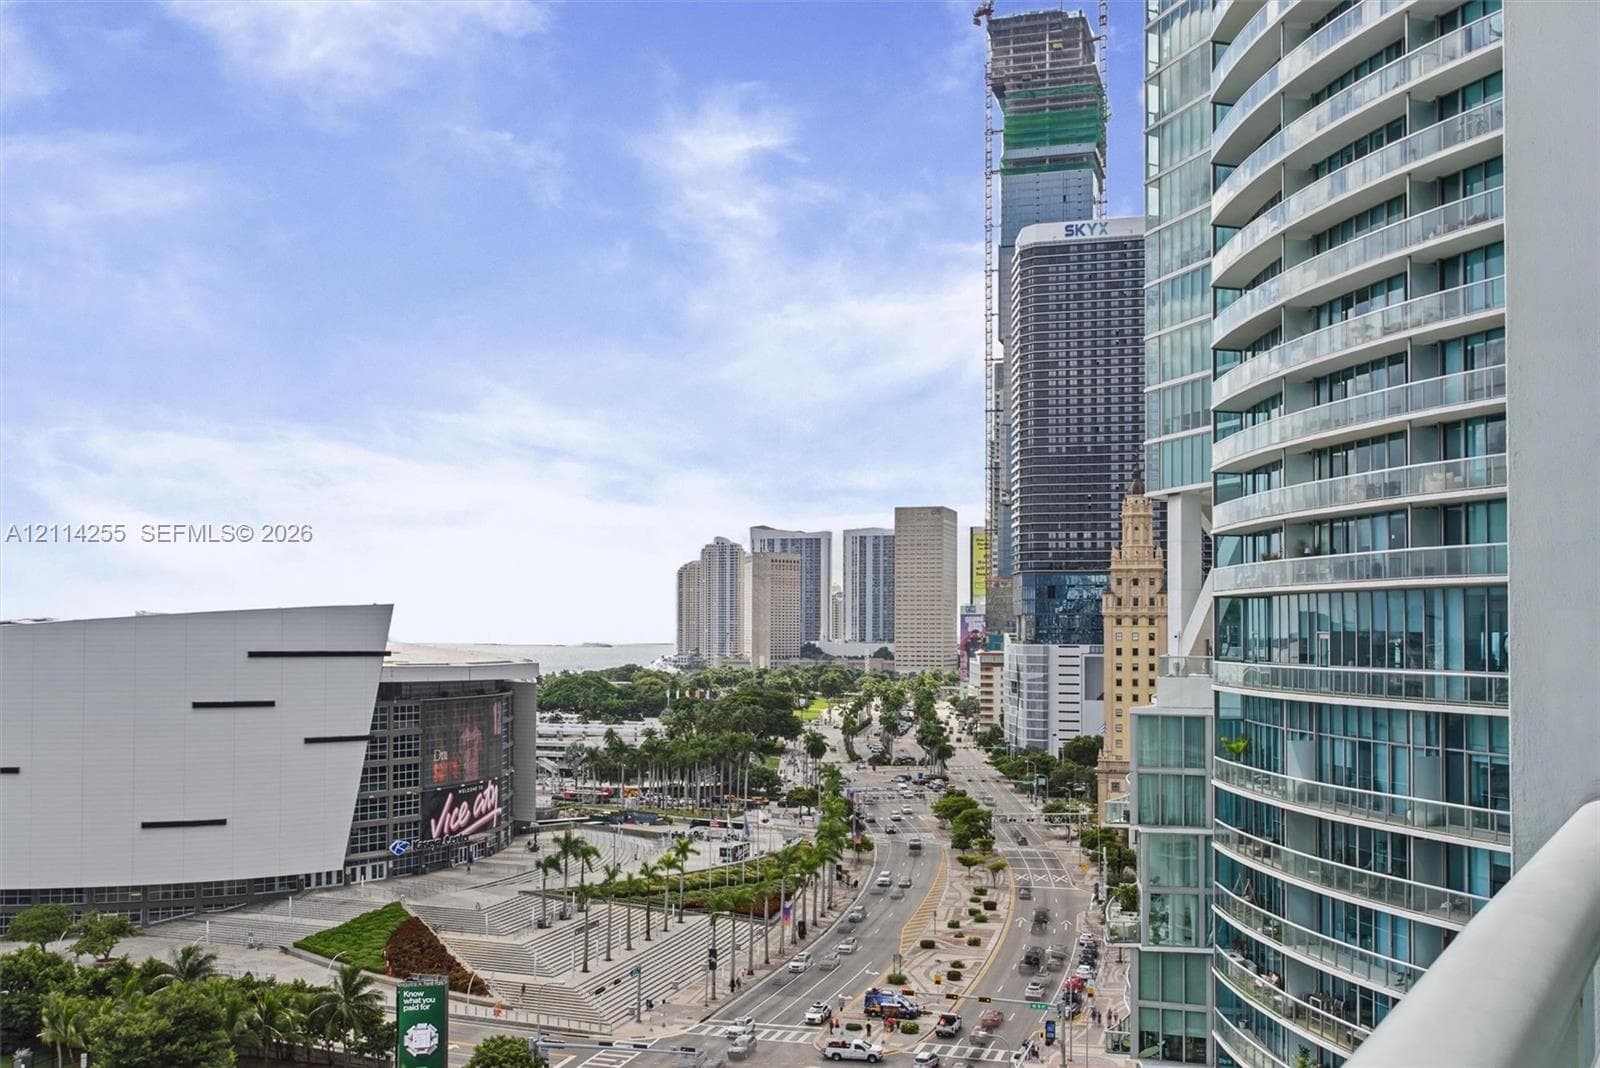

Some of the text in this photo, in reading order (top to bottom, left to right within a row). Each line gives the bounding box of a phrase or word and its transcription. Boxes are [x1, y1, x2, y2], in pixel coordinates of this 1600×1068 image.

[1064, 222, 1108, 237] SKYX
[430, 792, 471, 839] Vice
[421, 997, 436, 1005] you
[403, 1003, 431, 1013] paid for
